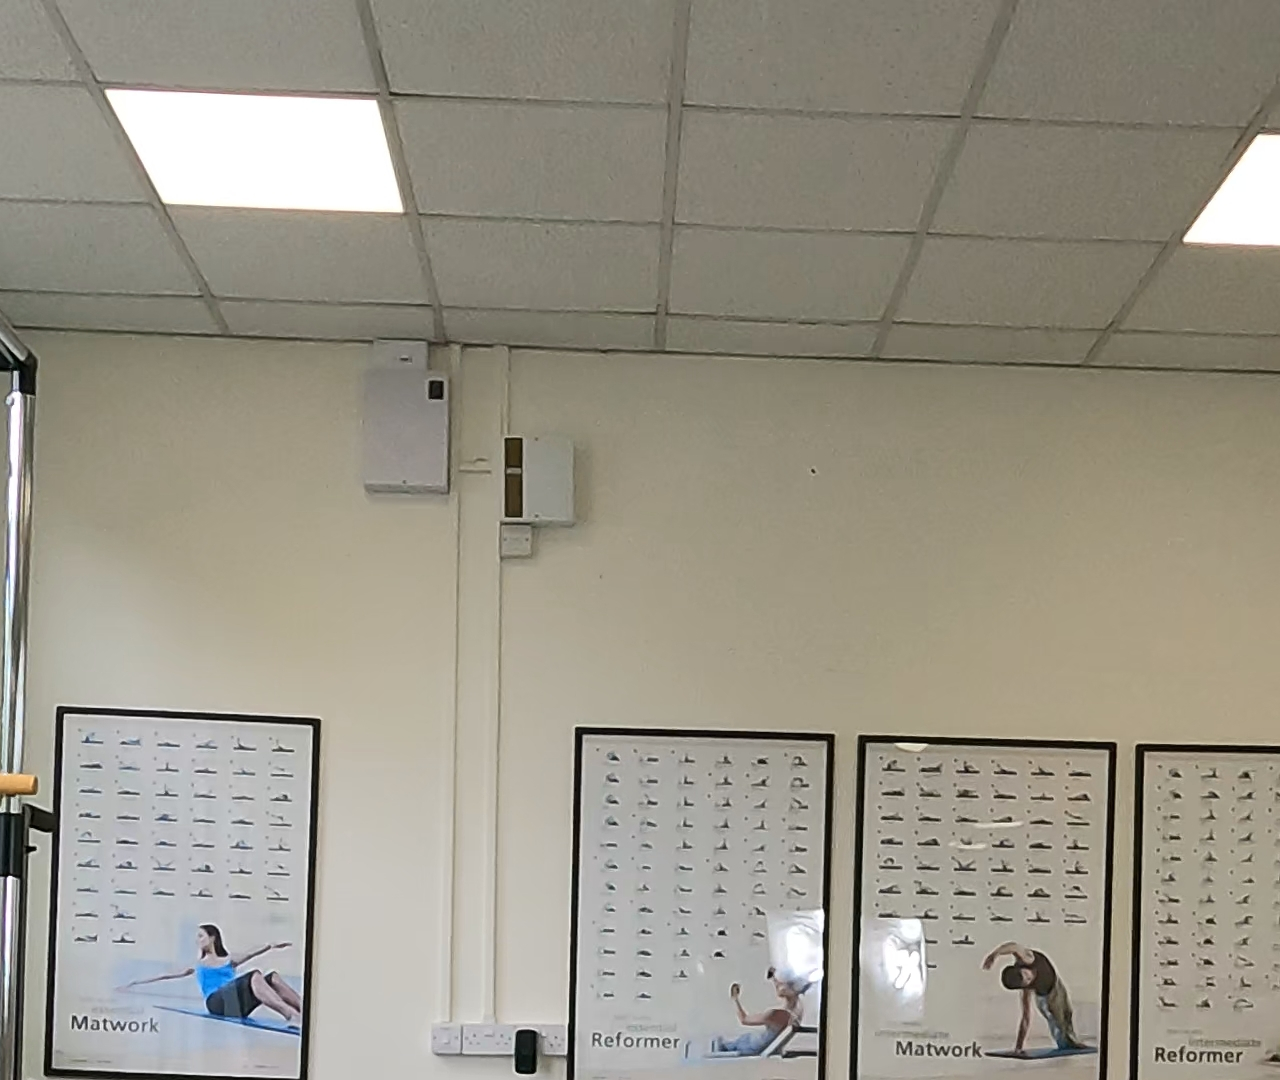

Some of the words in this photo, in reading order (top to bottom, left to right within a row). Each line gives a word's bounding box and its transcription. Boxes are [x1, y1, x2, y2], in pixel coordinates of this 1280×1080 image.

[71, 1015, 159, 1033] Matwork
[591, 1031, 681, 1050] Reformer
[896, 1041, 983, 1058] Matwork
[1154, 1046, 1243, 1063] Reformer
